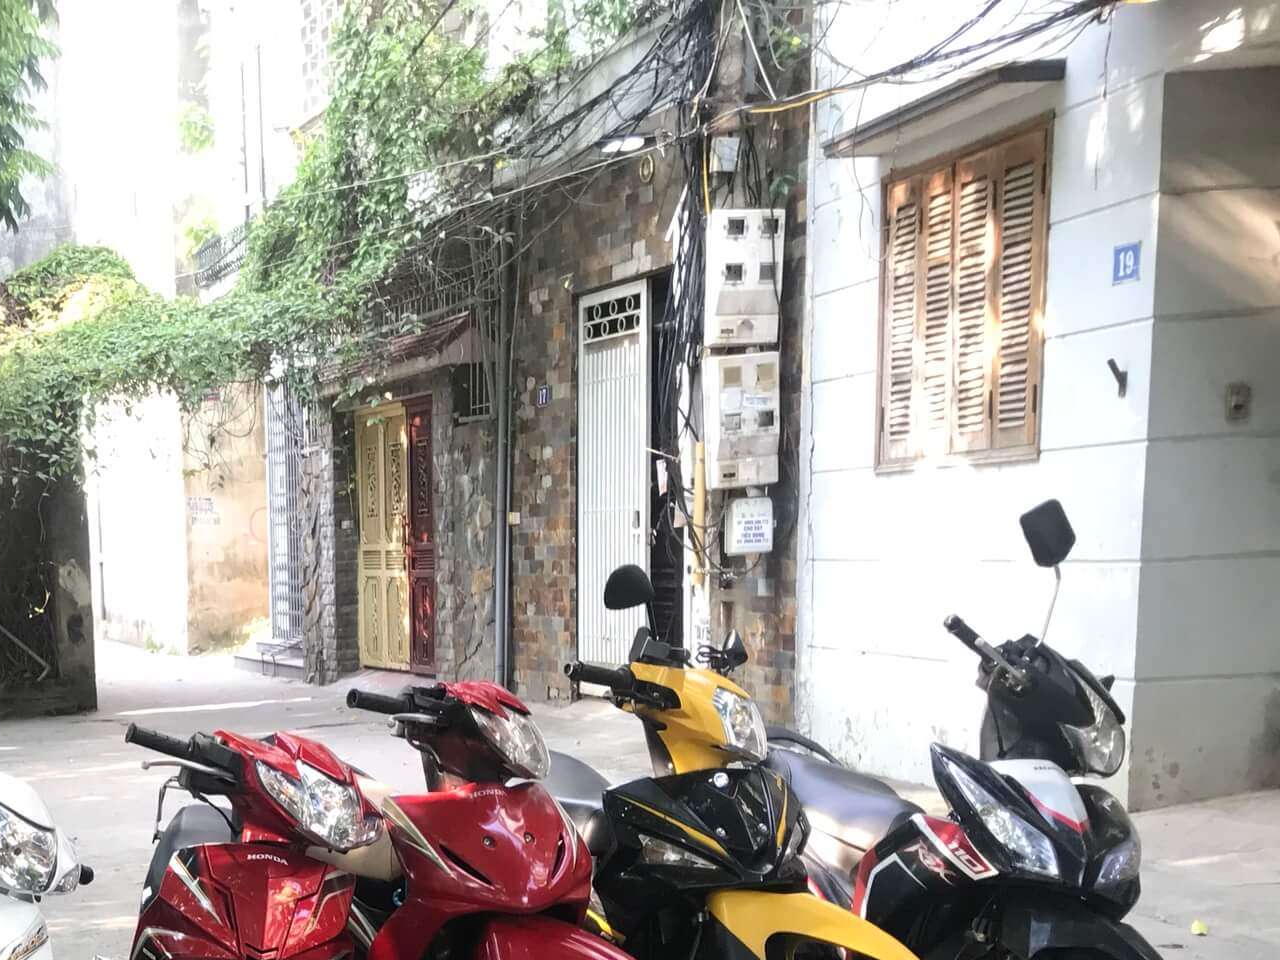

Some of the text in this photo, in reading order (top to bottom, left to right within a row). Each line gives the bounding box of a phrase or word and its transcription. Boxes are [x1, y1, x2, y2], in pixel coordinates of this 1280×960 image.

[1119, 250, 1134, 276] 19
[539, 388, 547, 405] 17
[247, 853, 289, 866] HONDA
